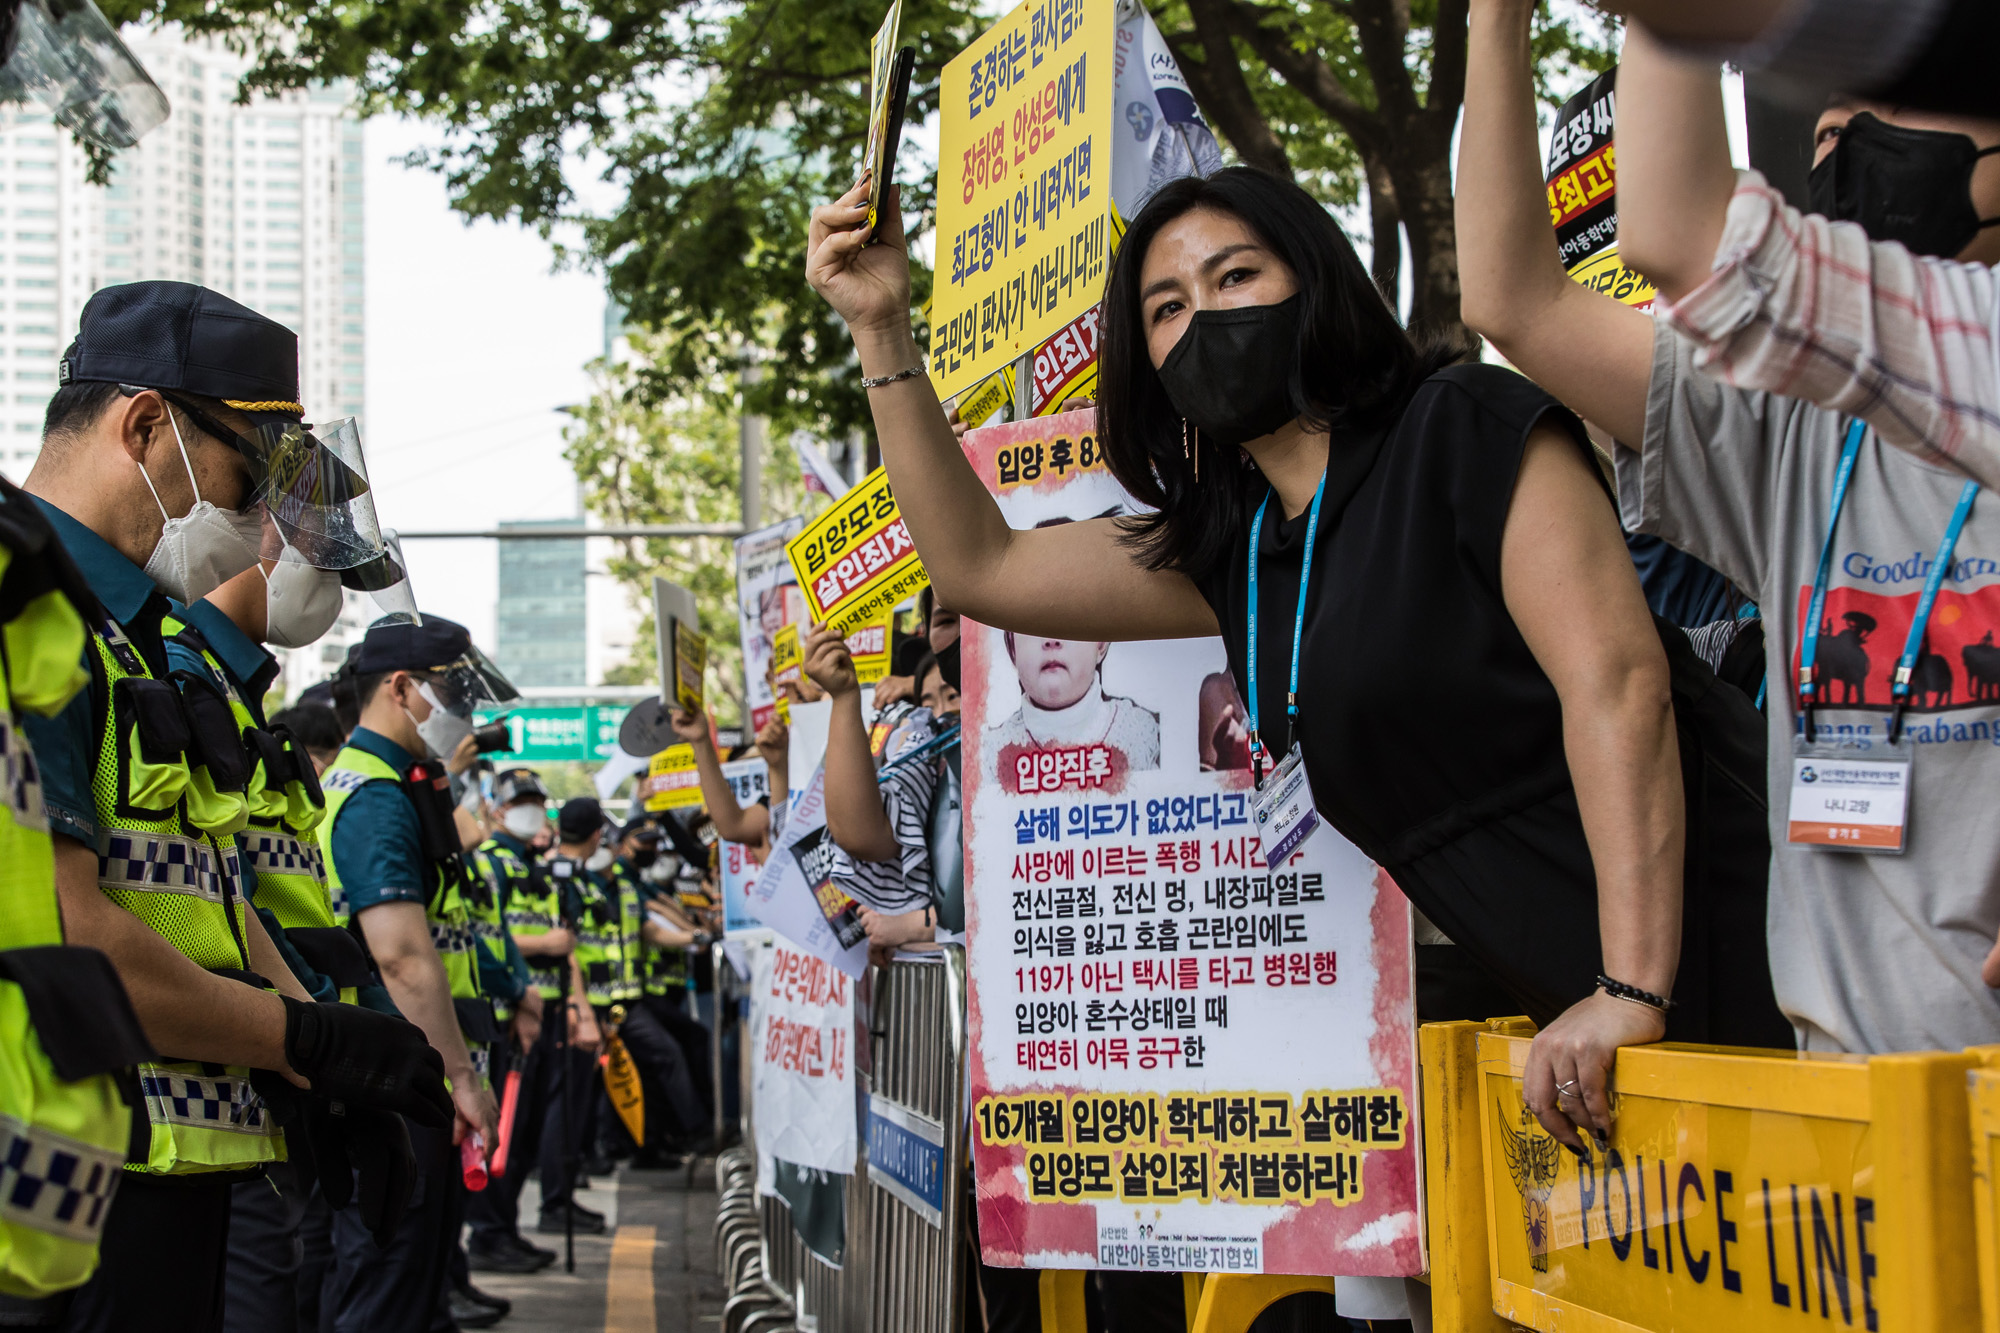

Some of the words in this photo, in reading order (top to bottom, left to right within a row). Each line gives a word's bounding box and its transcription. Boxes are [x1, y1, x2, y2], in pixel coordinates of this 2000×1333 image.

[969, 27, 1027, 120] 존경하는
[962, 120, 1008, 205] 장하영,
[1013, 51, 1087, 167] 안성은에게
[1545, 90, 1617, 179] 모장씨
[951, 198, 1009, 288] 최고형이
[1013, 185, 1029, 249] 안
[1032, 134, 1092, 231] 내려지면
[933, 302, 978, 380] 국민의
[981, 270, 1027, 353] 판사가
[1030, 213, 1105, 319] 아닙니다!!!
[998, 442, 1044, 484] 입양
[1049, 438, 1073, 476] 후
[1079, 436, 1103, 468] 8
[1016, 748, 1112, 792] 입양직후
[1014, 807, 1061, 844] 살해
[1068, 802, 1139, 840] 의도가
[1146, 792, 1257, 834] 없었다고
[1011, 849, 1075, 884] 사망에
[1083, 843, 1148, 879] 이르는
[1155, 839, 1201, 873] 폭행
[1012, 883, 1104, 921] 전신골절,
[1112, 879, 1157, 917] 전신
[1164, 879, 1194, 913] 멍,
[1204, 873, 1325, 910] 내장파열로
[1013, 923, 1076, 958] 의식을
[1084, 919, 1128, 956] 잃고
[1135, 917, 1180, 952] 호흡
[1187, 914, 1308, 949] 곤란임에도
[1015, 961, 1074, 994] 119가
[1081, 959, 1124, 993] 아닌
[1133, 956, 1200, 991] 택시를
[1208, 954, 1255, 986] 타고
[1263, 950, 1338, 987] 병원행
[1015, 1000, 1078, 1034] 입양아
[1085, 996, 1197, 1032] 혼수상태일
[1205, 995, 1228, 1028] 때
[1016, 1039, 1079, 1071] 태연히
[1086, 1037, 1130, 1071] 어묵
[1136, 1036, 1206, 1069] 공구한
[978, 1098, 1064, 1144] 16개월
[1072, 1098, 1158, 1143] 입양아
[1167, 1096, 1292, 1143] 학대하고
[1300, 1094, 1402, 1142] 살해한
[1029, 1152, 1115, 1198] 입양모
[1120, 1152, 1209, 1198] 살인죄
[1218, 1151, 1359, 1199] 처벌하라!
[1100, 1226, 1128, 1240] 사단법인
[1101, 1244, 1258, 1270] 대한아동학대방지협회
[1578, 1144, 1742, 1294] POLICE
[1762, 1178, 1880, 1332] LINE
